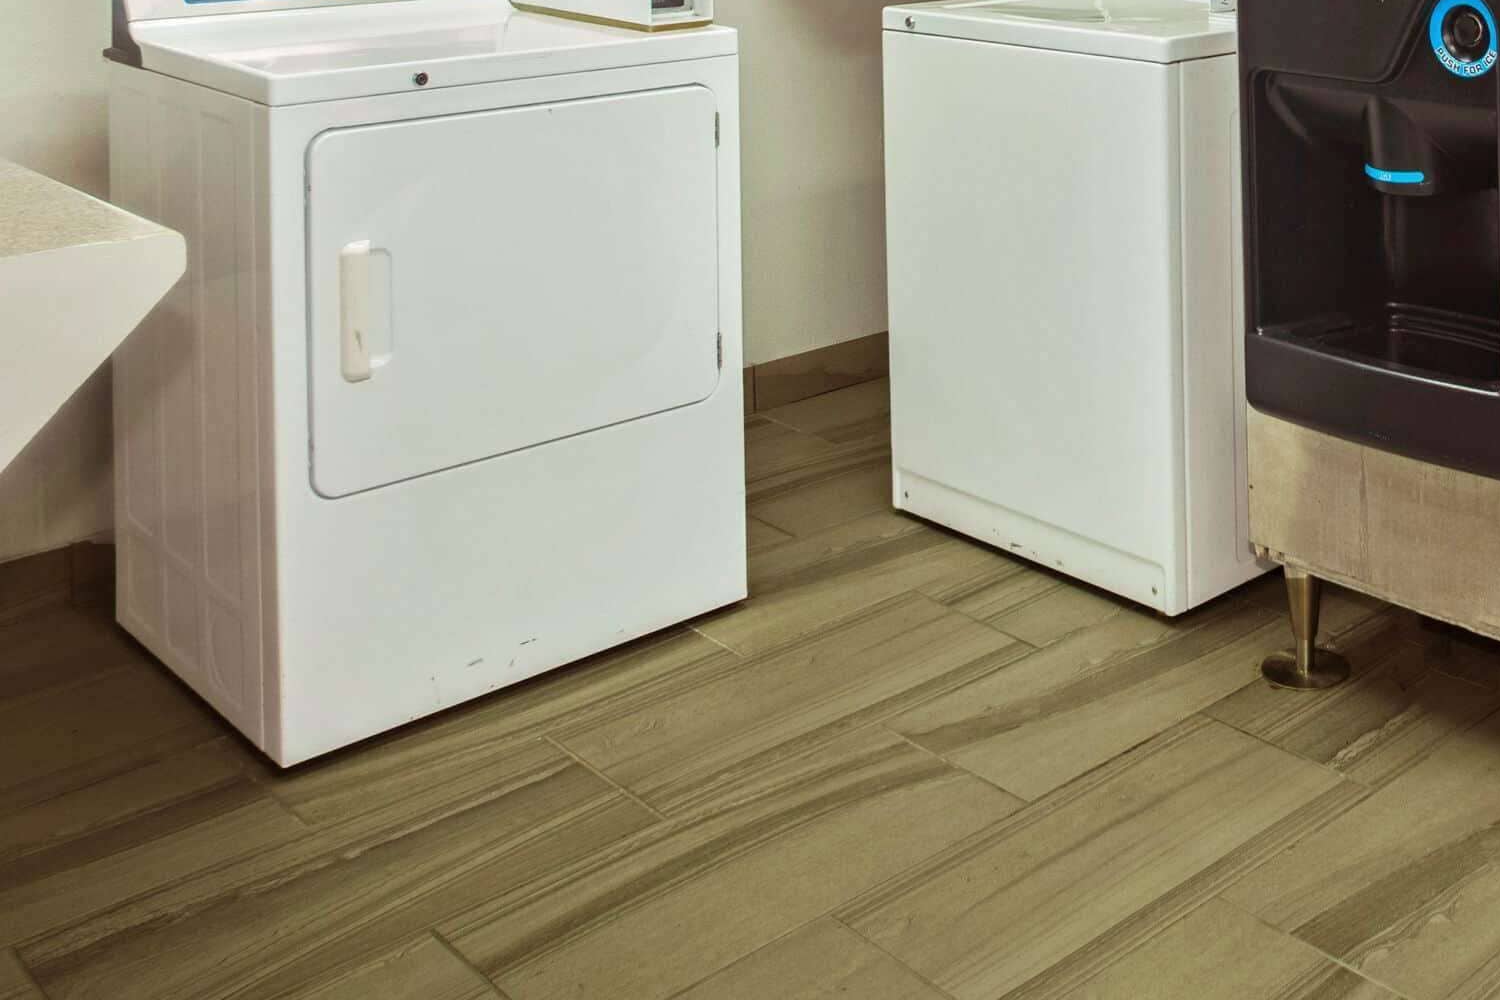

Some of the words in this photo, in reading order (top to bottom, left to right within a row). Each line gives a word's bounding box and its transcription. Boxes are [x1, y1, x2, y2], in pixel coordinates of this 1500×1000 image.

[1435, 47, 1461, 73] PUSH
[1463, 63, 1483, 74] FOR
[1483, 51, 1497, 67] ICE
